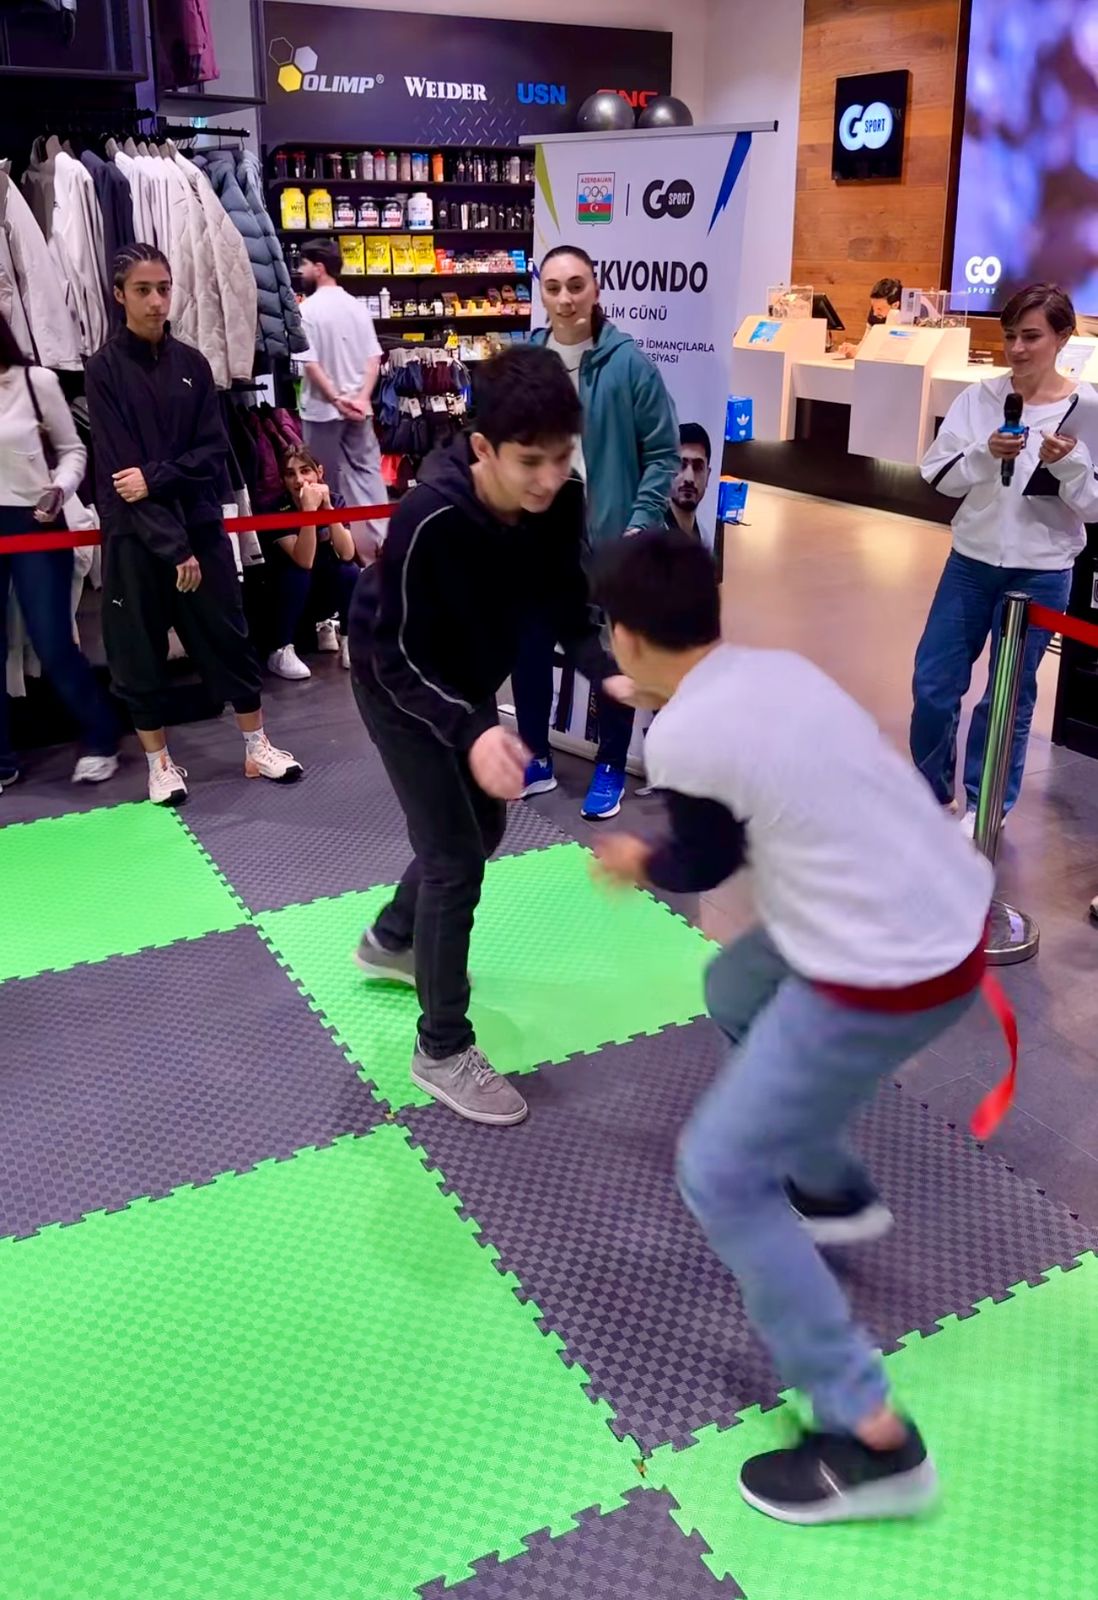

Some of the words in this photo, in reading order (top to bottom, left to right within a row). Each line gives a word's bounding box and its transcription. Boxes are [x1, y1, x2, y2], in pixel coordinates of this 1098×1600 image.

[404, 76, 487, 101] WEIDER
[517, 82, 566, 105] USN
[839, 102, 893, 151] GO
[865, 118, 886, 134] SPORT
[642, 179, 695, 219] GO
[668, 192, 691, 205] SPORT
[591, 260, 708, 293] KVONDO
[965, 255, 1002, 284] GO
[967, 287, 996, 295] SPORT
[604, 303, 625, 319] LİM
[629, 304, 668, 321] GÜNÜ
[646, 337, 715, 353] İDMANÇILARLA
[647, 351, 679, 364] SİYASI
